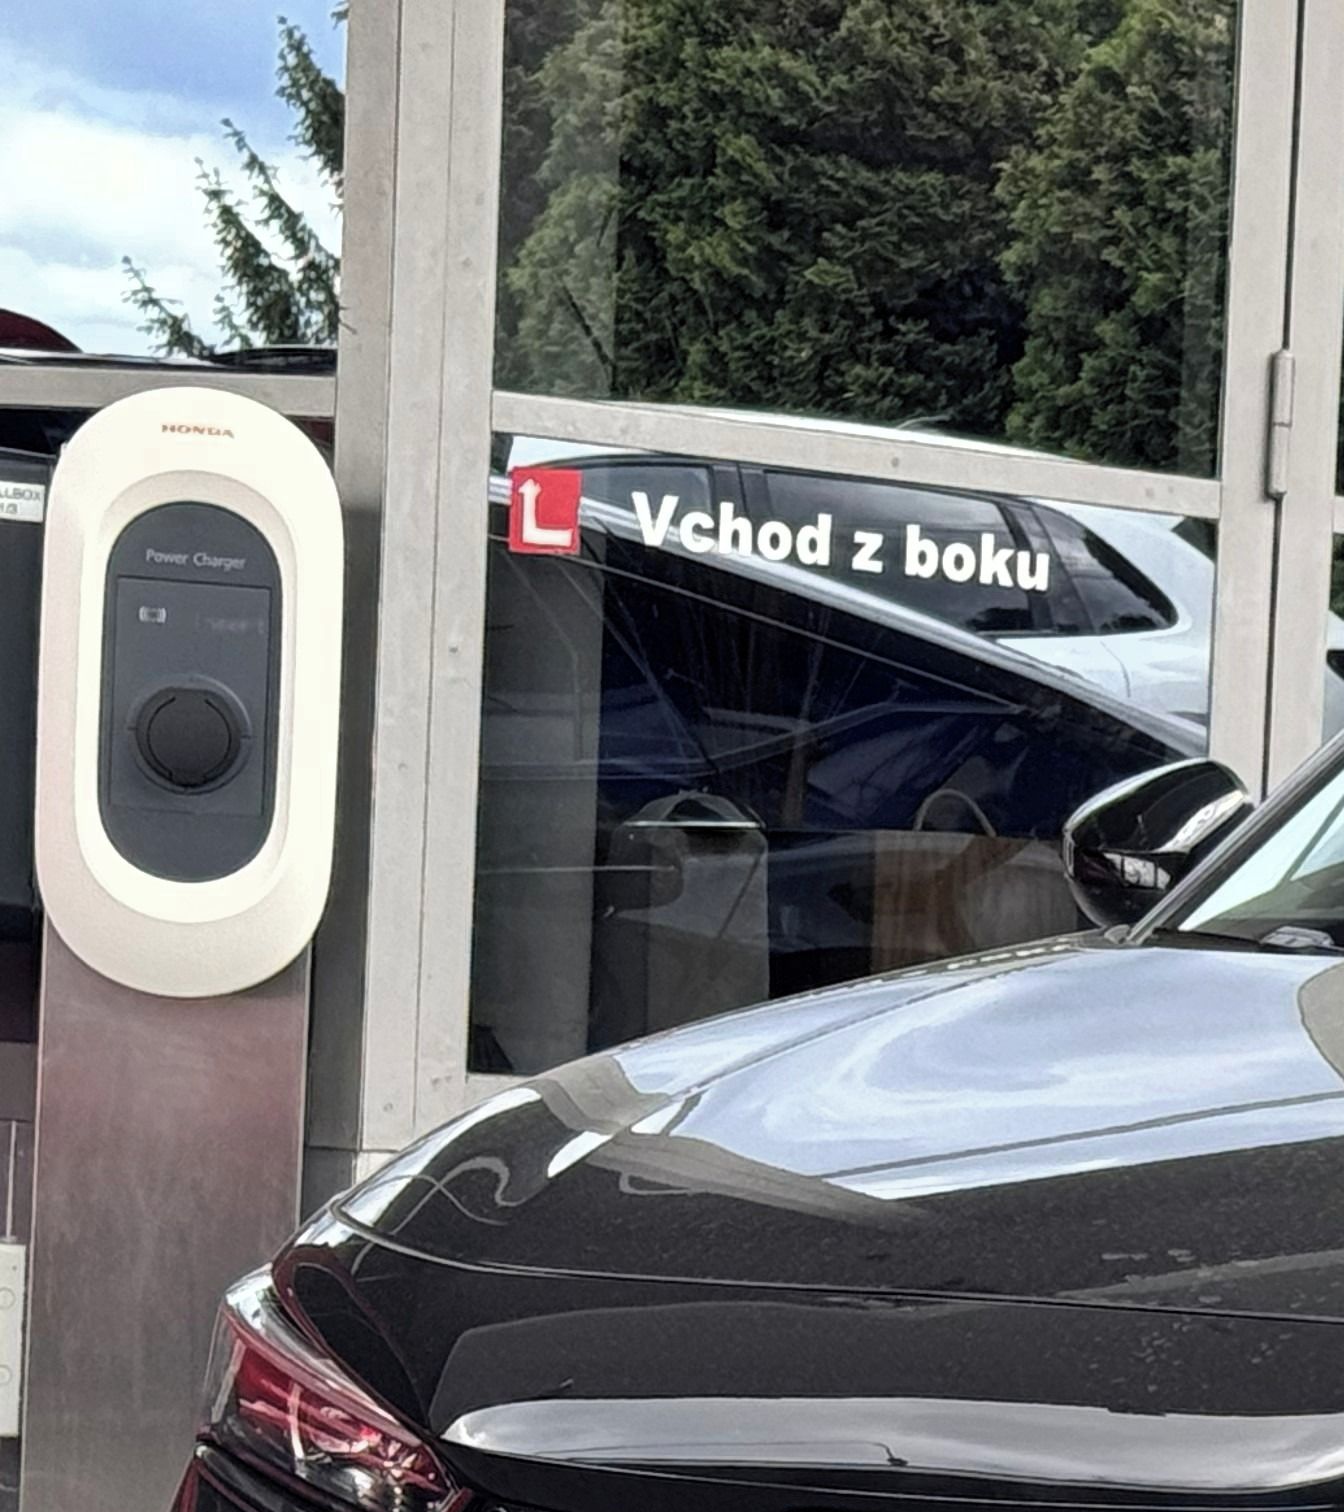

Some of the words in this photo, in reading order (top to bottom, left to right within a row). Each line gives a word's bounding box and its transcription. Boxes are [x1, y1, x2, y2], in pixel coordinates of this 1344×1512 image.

[161, 424, 235, 438] HONDA
[631, 491, 832, 566] Vchod
[852, 531, 884, 574] z
[904, 524, 1051, 592] boku
[146, 549, 189, 566] Power
[193, 552, 247, 572] Charger
